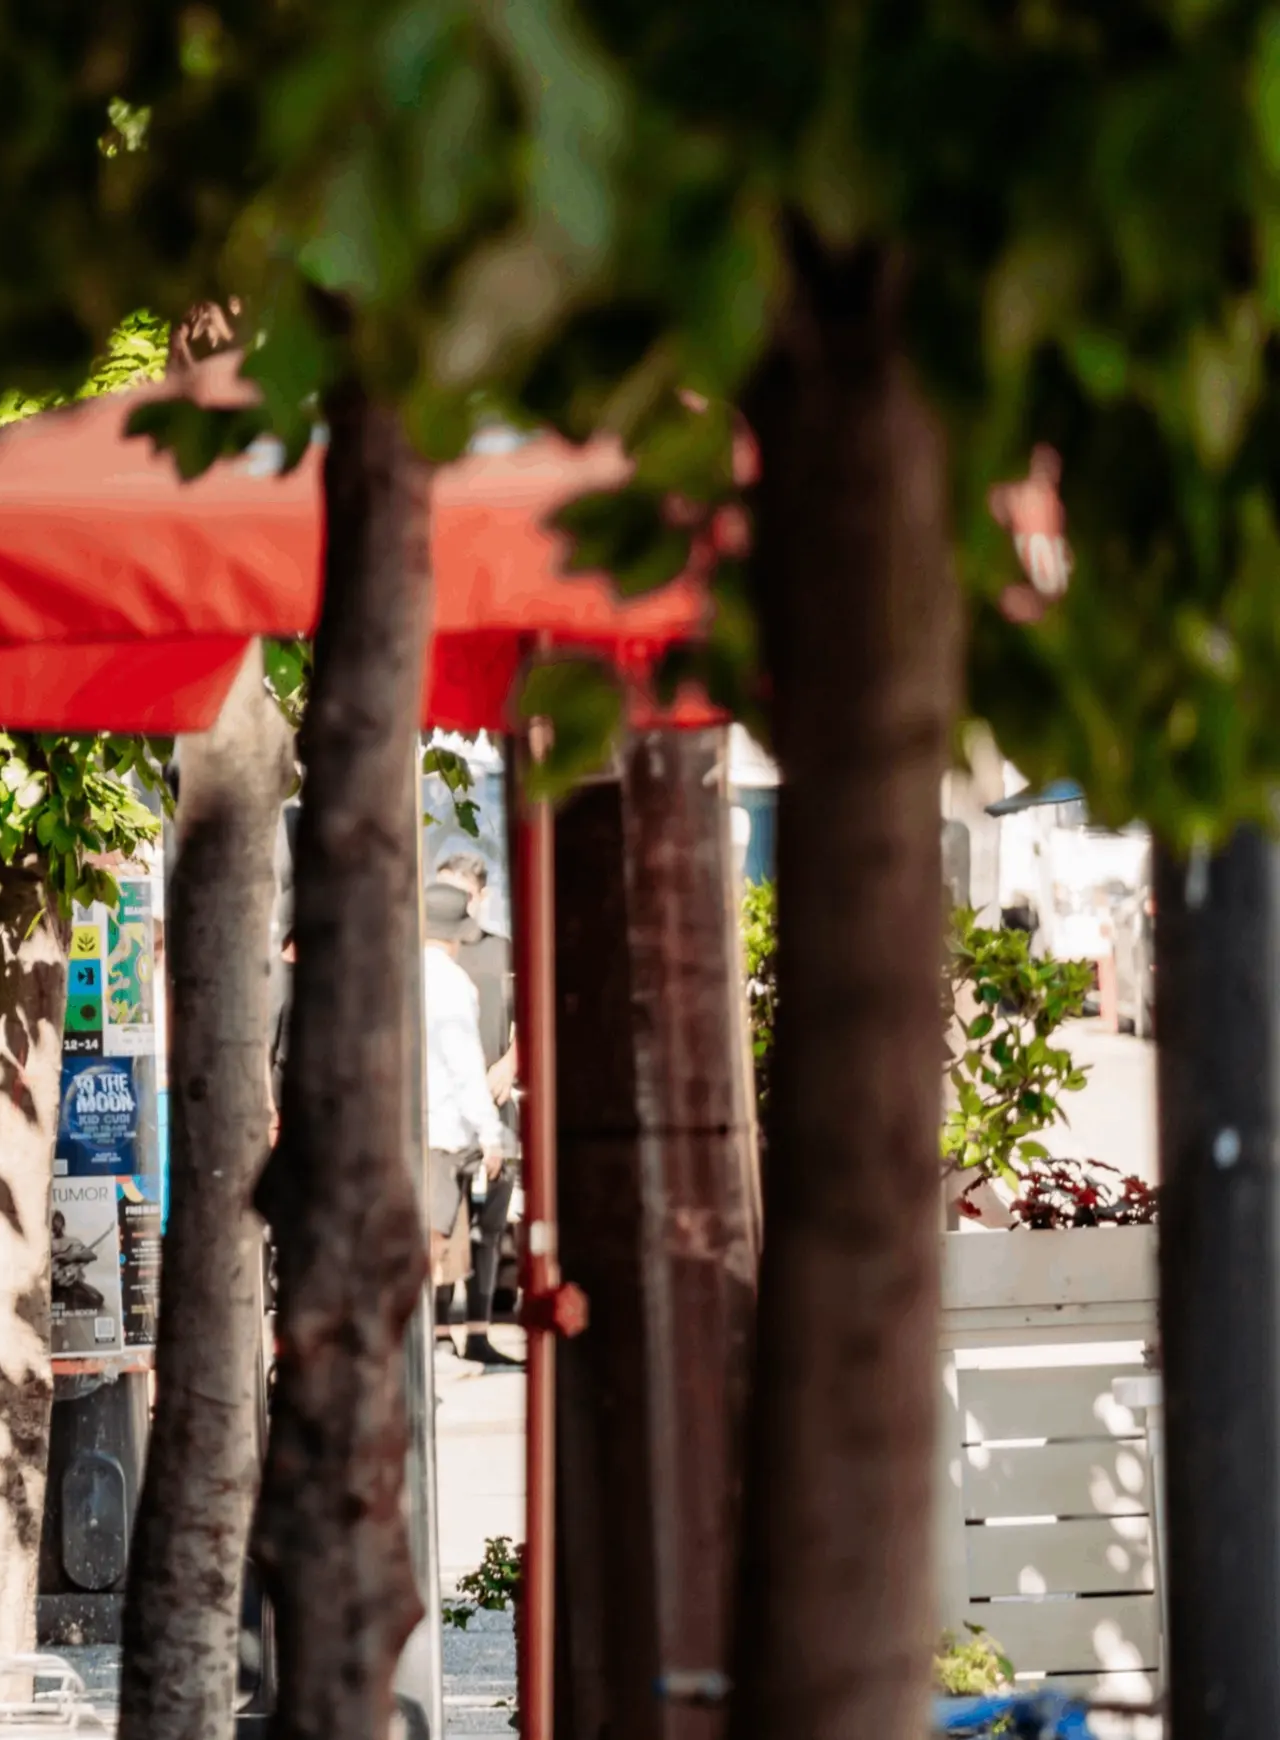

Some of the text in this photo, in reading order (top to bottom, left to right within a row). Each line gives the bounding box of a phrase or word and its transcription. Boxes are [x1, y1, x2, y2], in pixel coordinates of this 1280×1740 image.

[63, 1039, 99, 1051] 12-14
[98, 1073, 128, 1093] THE
[76, 1092, 136, 1113] MOON
[52, 1186, 109, 1203] TUMOR
